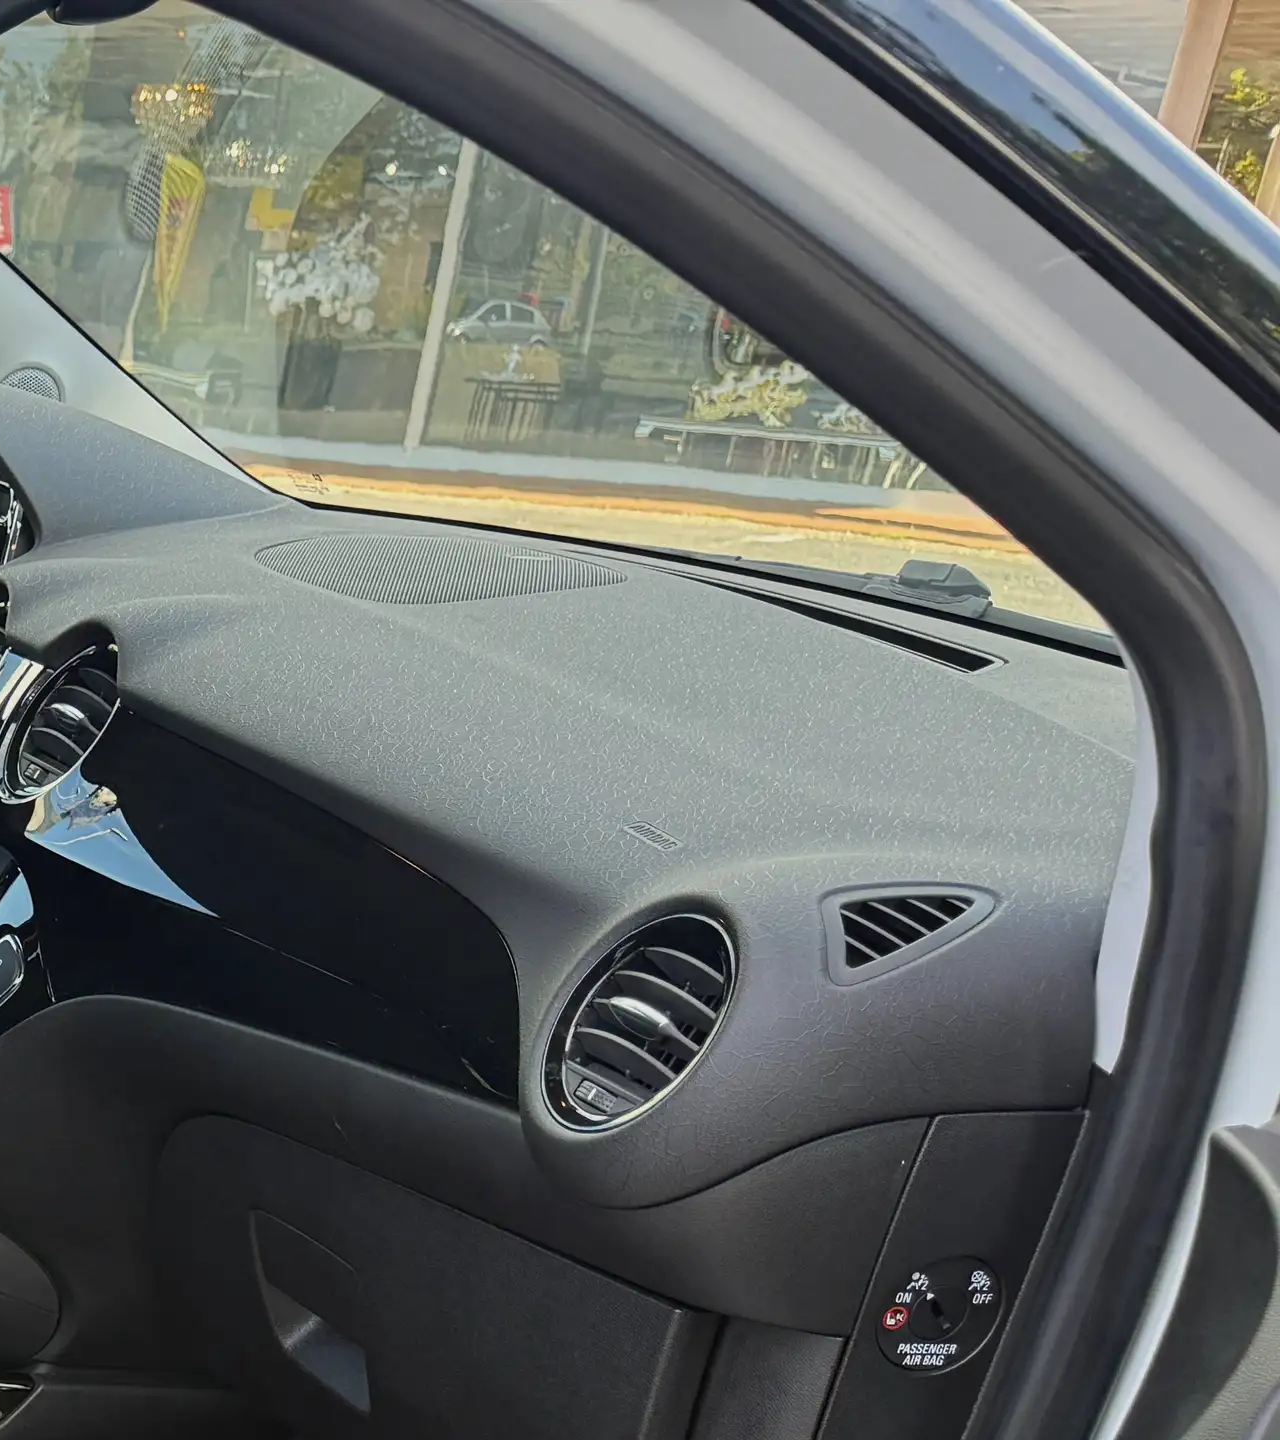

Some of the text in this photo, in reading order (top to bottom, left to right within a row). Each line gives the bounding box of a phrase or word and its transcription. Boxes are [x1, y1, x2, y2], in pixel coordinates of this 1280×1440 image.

[895, 1292, 913, 1304] ON
[972, 1293, 994, 1305] OFF
[896, 1343, 958, 1355] PASSENGER
[902, 1355, 945, 1366] AIR BAG
